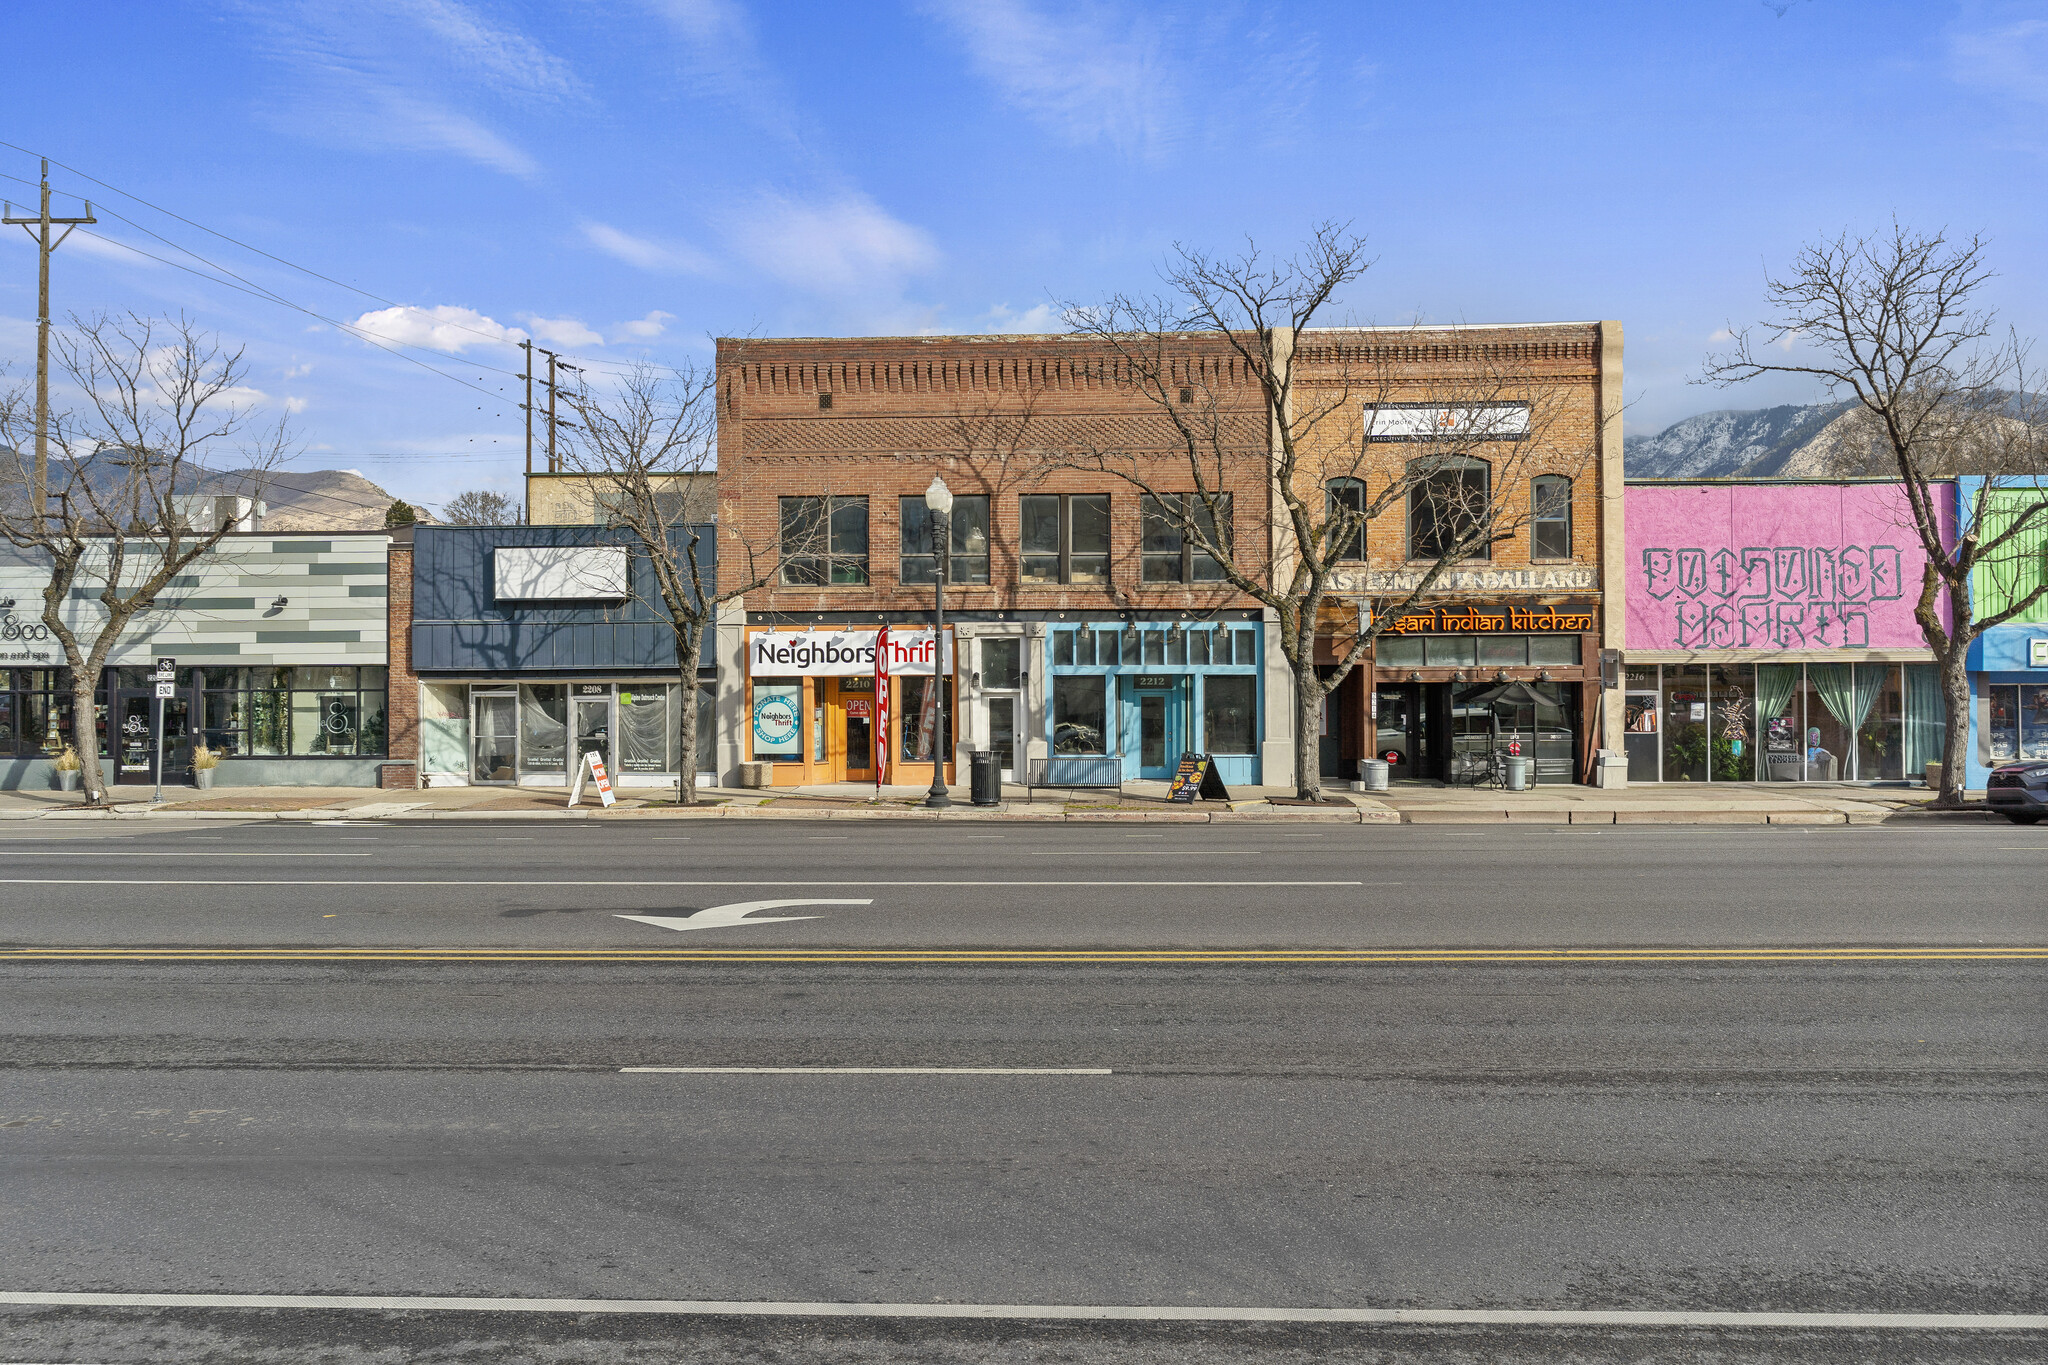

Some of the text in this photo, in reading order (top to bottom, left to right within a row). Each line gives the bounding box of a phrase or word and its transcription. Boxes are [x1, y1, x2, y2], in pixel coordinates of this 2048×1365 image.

[1389, 418, 1413, 426] Moore
[1370, 605, 1592, 634] sari indian kitchen
[11, 650, 30, 661] and
[32, 652, 49, 662] spa
[758, 640, 944, 668] Neighbors hrif
[846, 680, 870, 689] 2210
[1140, 677, 1165, 686] 2212
[159, 686, 171, 695] END
[582, 685, 602, 694] 2208
[754, 695, 799, 717] DONATE HERE
[847, 700, 871, 711] OPEN
[761, 712, 792, 722] Neighbors
[756, 727, 797, 743] SHOP HERE
